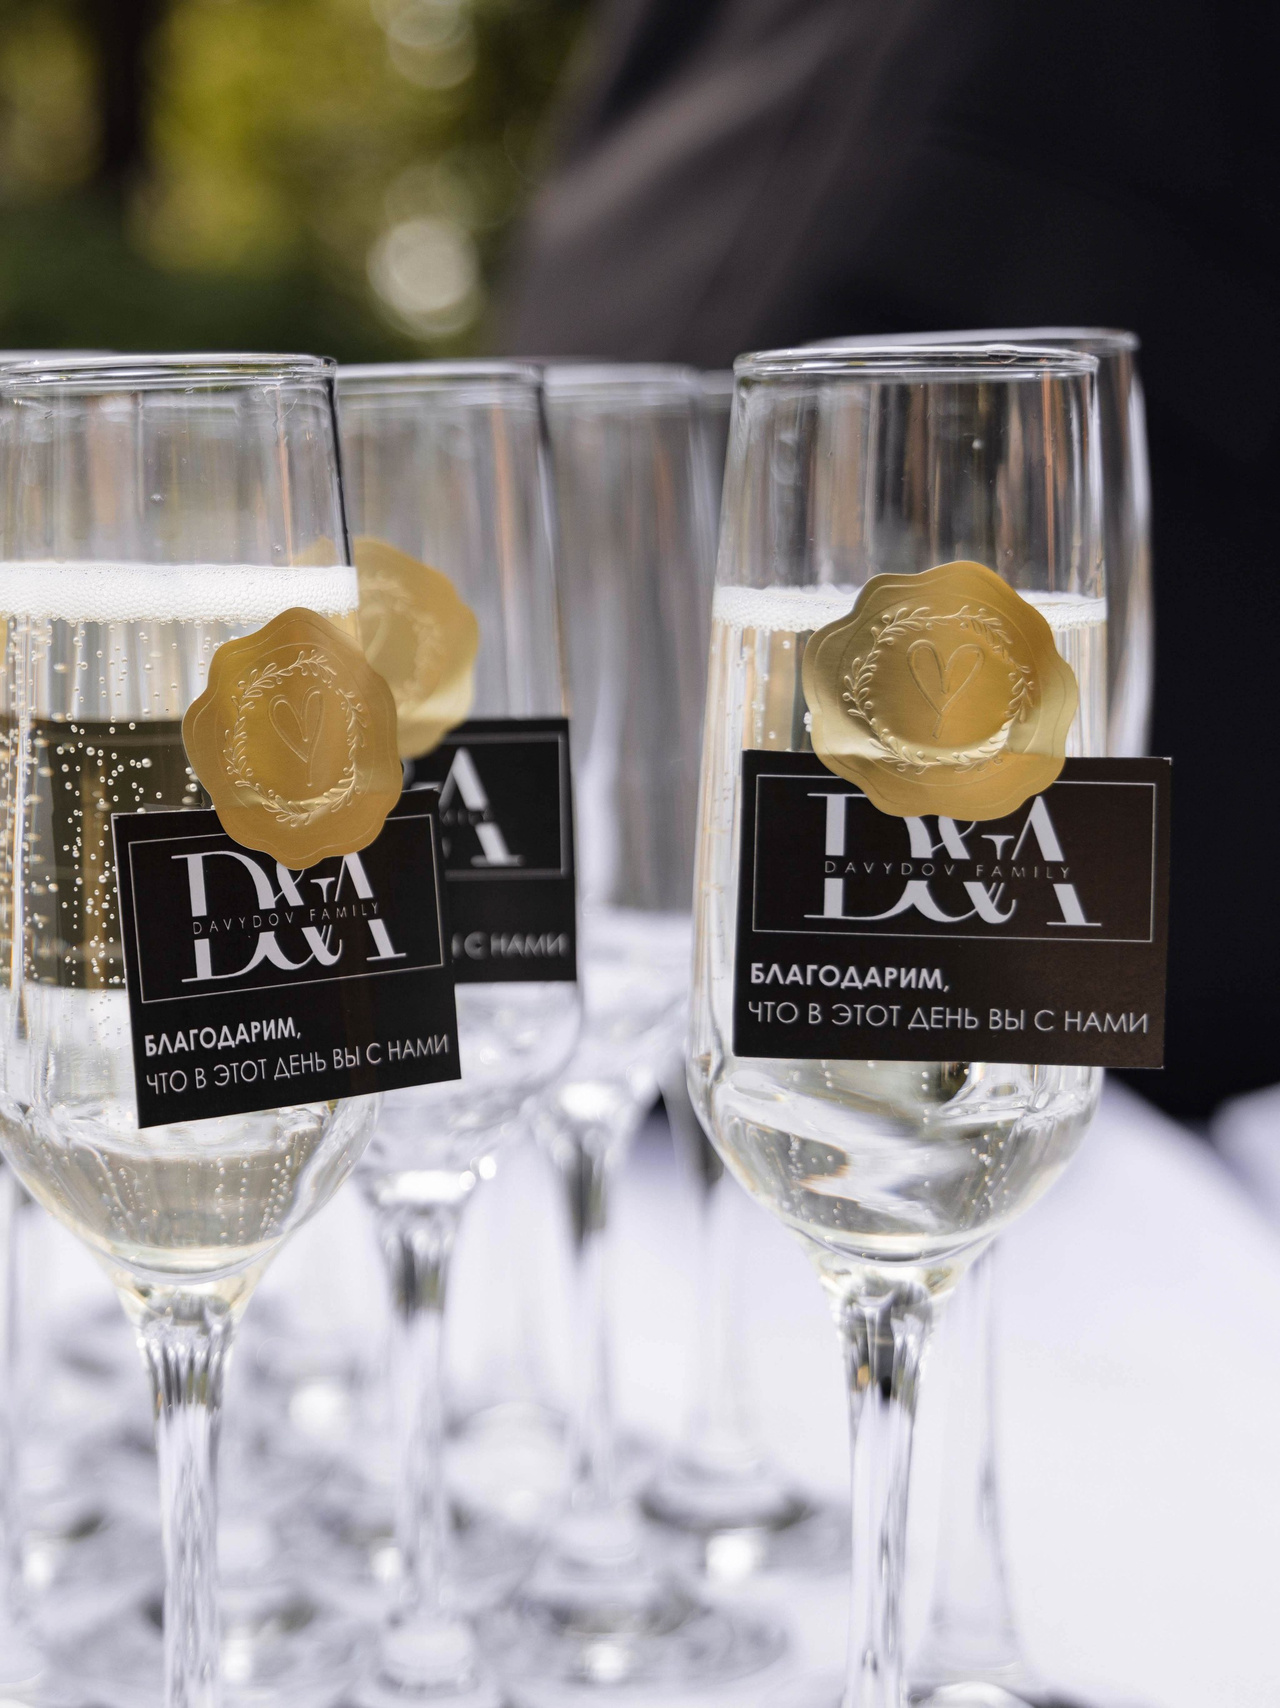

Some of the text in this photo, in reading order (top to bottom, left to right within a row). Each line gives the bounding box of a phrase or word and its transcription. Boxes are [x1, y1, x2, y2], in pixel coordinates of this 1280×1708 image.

[824, 860, 1071, 880] DAVYDOV FAMILY
[192, 902, 380, 935] DAVYDOV FAMILY
[750, 963, 950, 993] БЛАГОДАРИМ,
[748, 1001, 1148, 1034] ЧТО В ЭТОТ ДЕНЬ ВЫ С НАМИ
[144, 1017, 302, 1057] БЛАГОДАРИМ,
[147, 1034, 448, 1095] ЧТО В ЭТОТ ДЕНЬ ВЫ С НАМИ
